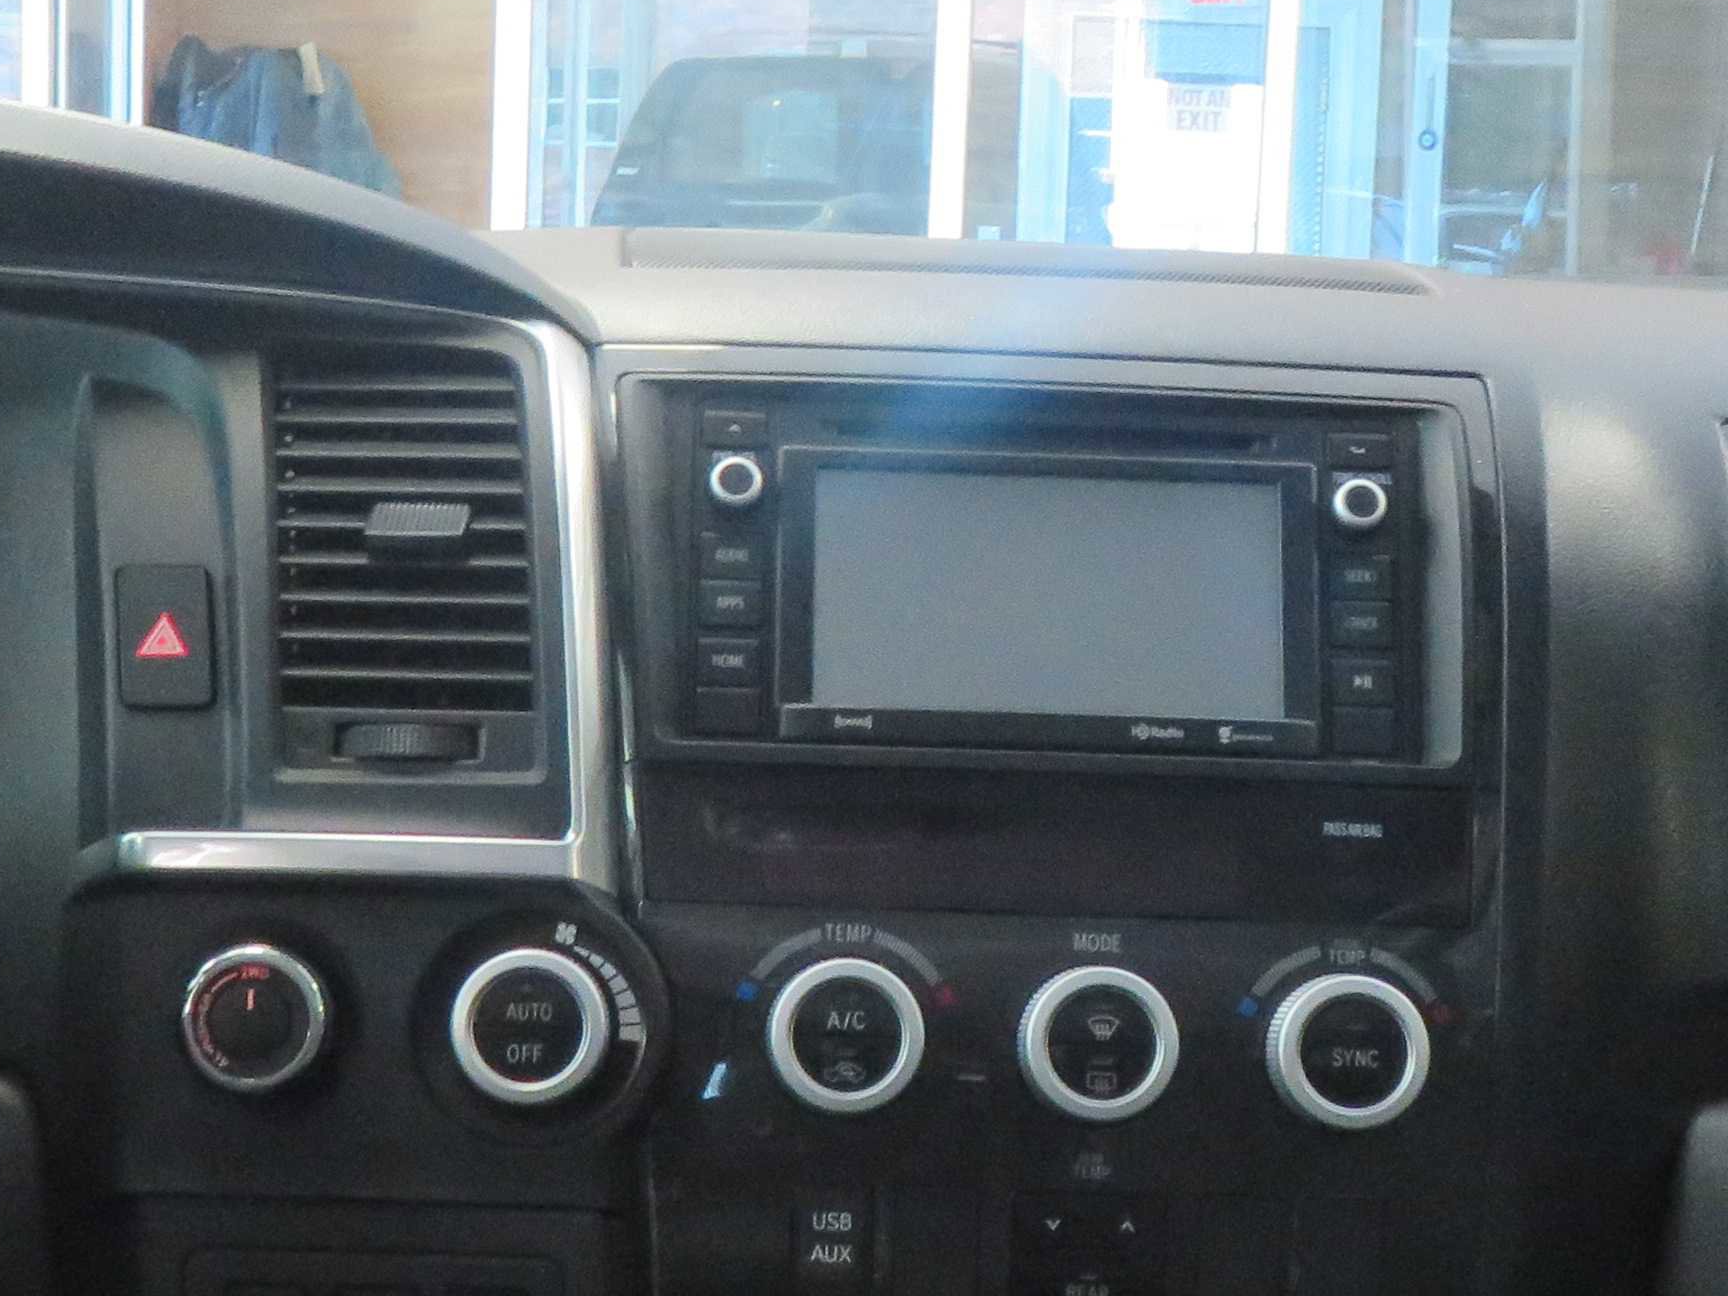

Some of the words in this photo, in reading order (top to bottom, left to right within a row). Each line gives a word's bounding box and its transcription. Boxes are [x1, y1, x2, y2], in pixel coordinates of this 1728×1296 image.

[1176, 109, 1222, 132] EXIT
[825, 922, 872, 944] TEMP
[1072, 932, 1121, 954] MODE
[1329, 949, 1366, 966] TEMP
[506, 1002, 552, 1022] AUTO
[826, 1011, 865, 1030] A/C
[506, 1043, 543, 1064] OFF
[1332, 1047, 1379, 1069] SYNC
[812, 1211, 852, 1232] USB
[810, 1244, 852, 1264] AUX
